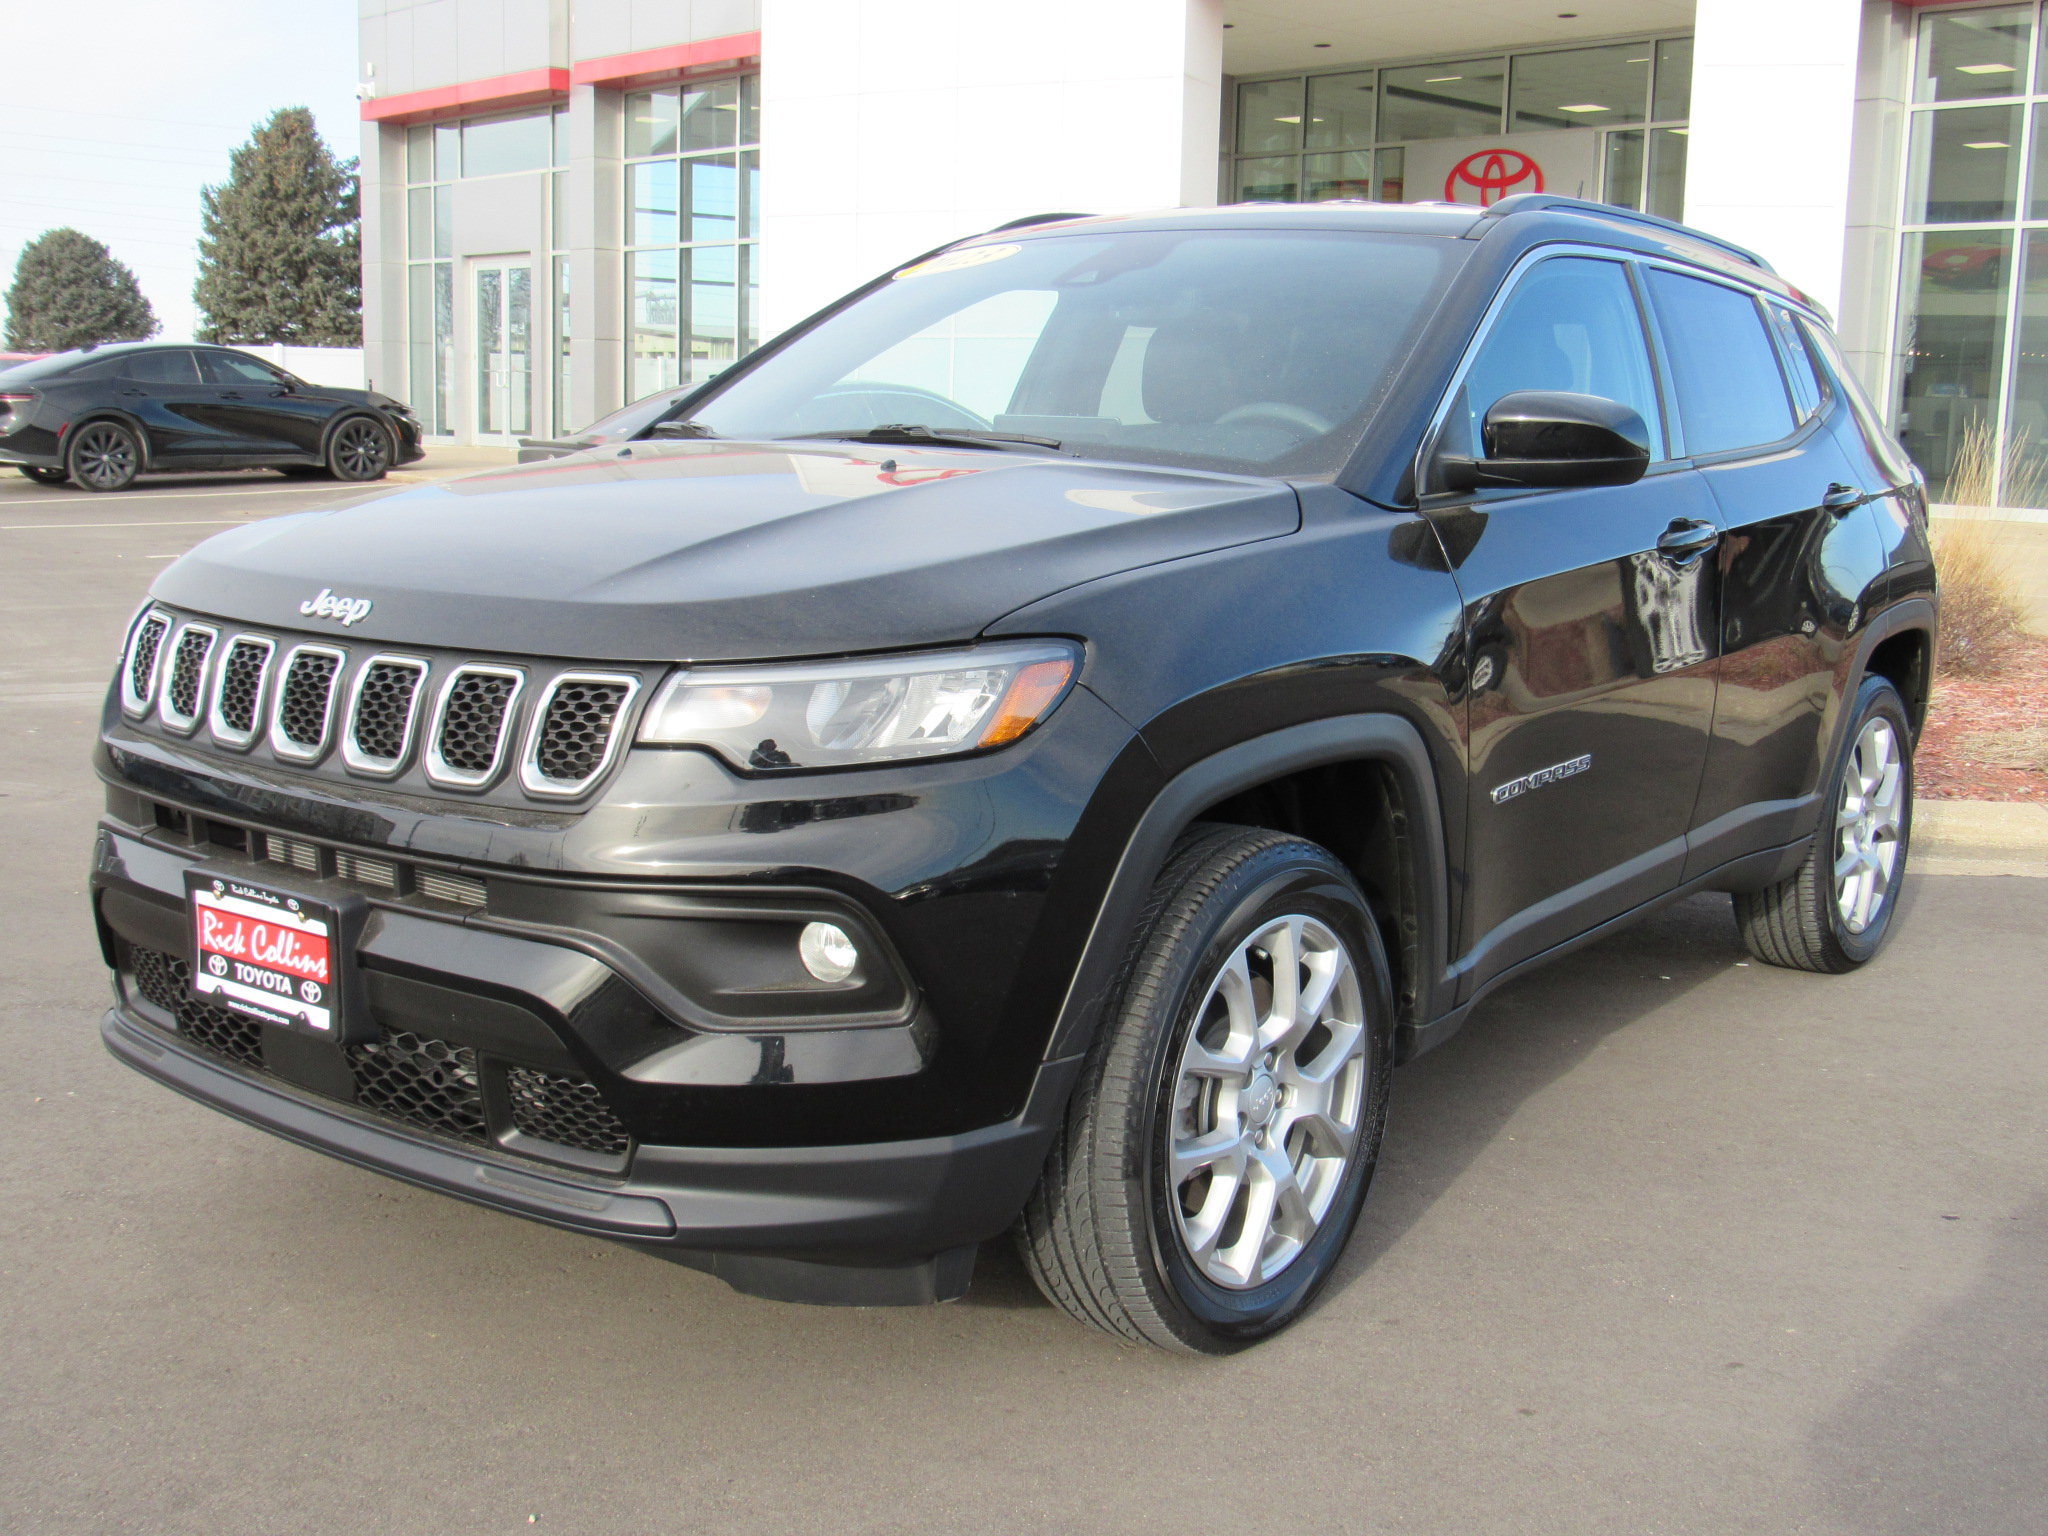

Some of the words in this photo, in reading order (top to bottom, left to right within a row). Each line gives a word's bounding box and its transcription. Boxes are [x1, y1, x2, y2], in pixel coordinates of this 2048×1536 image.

[300, 589, 373, 627] Jeep
[1490, 754, 1591, 804] COMPASS
[203, 910, 246, 955] Rick
[252, 924, 328, 978] Collins
[234, 962, 293, 995] TOYOTA
